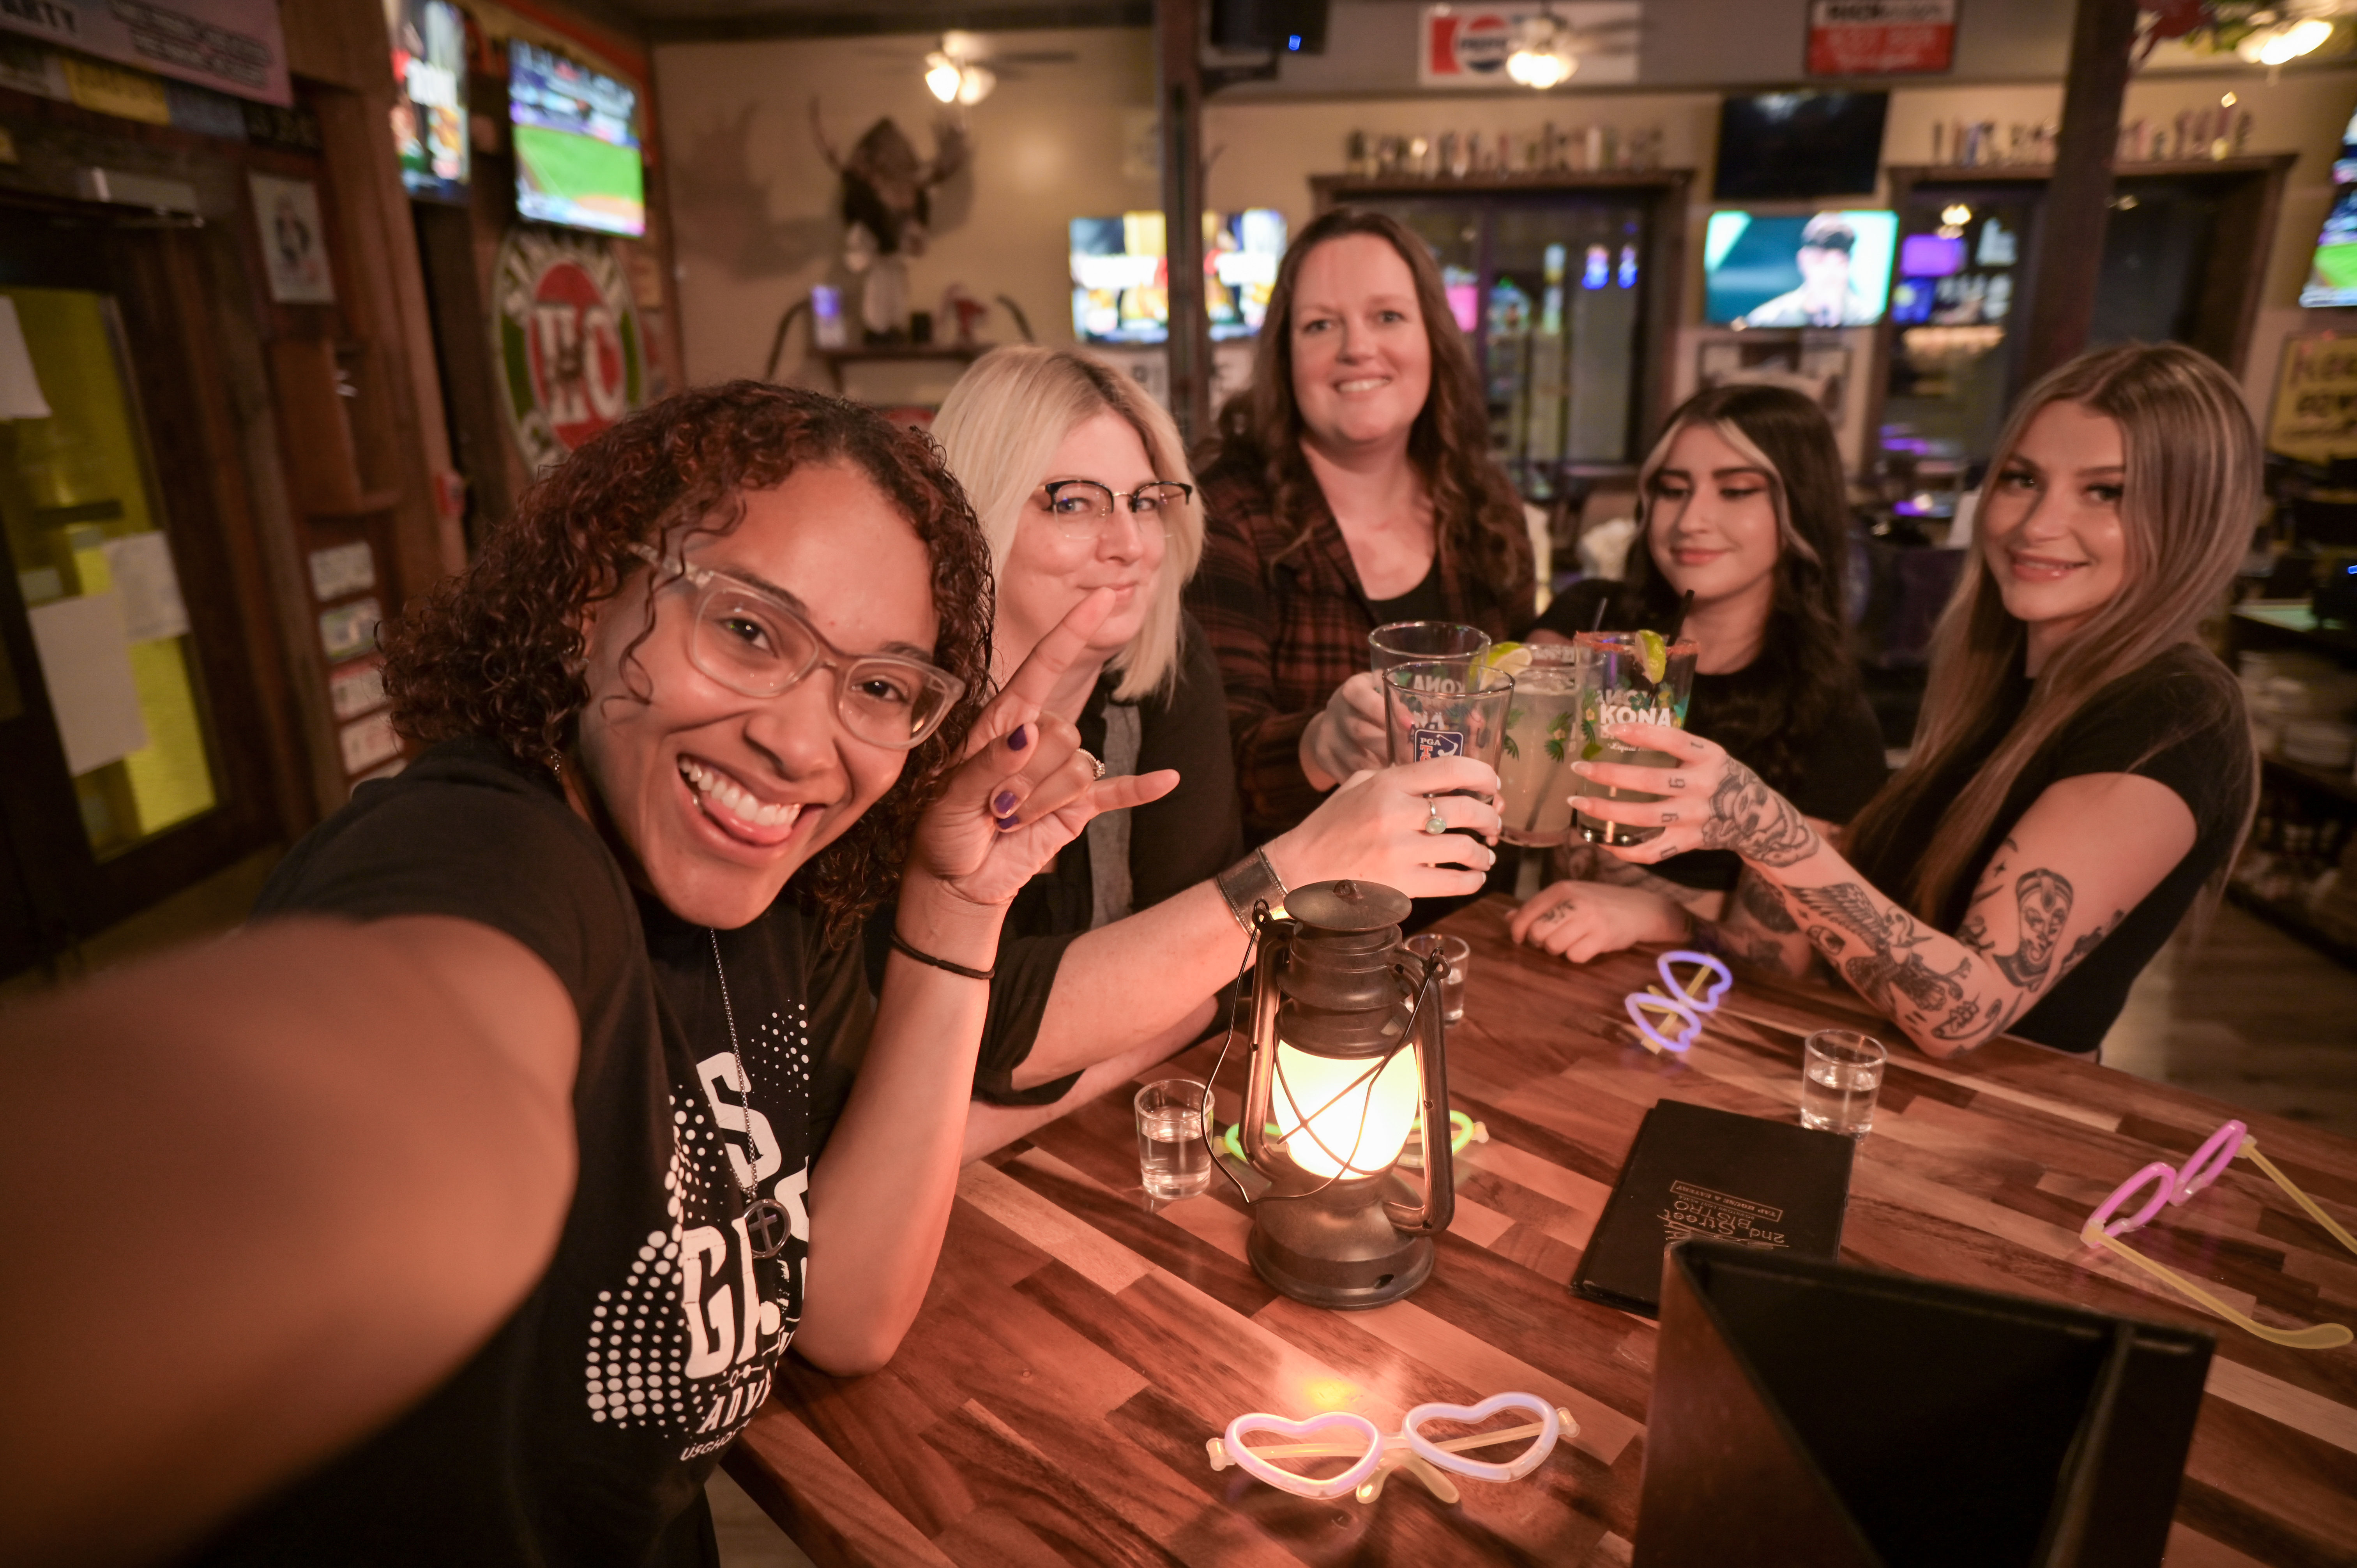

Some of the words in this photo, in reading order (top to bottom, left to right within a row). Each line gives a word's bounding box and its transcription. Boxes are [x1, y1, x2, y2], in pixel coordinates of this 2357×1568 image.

[1600, 704, 1671, 727] KONA
[1420, 737, 1441, 746] PGA
[1676, 1185, 1712, 1199] EATERY
[1723, 1198, 1755, 1210] HOUSE
[1674, 1201, 1752, 1230] BISTRO
[1718, 1207, 1755, 1220] DOWNTOWN
[1757, 1209, 1776, 1217] TAP
[1664, 1209, 1733, 1235] Street
[1749, 1228, 1785, 1243] 2nd
